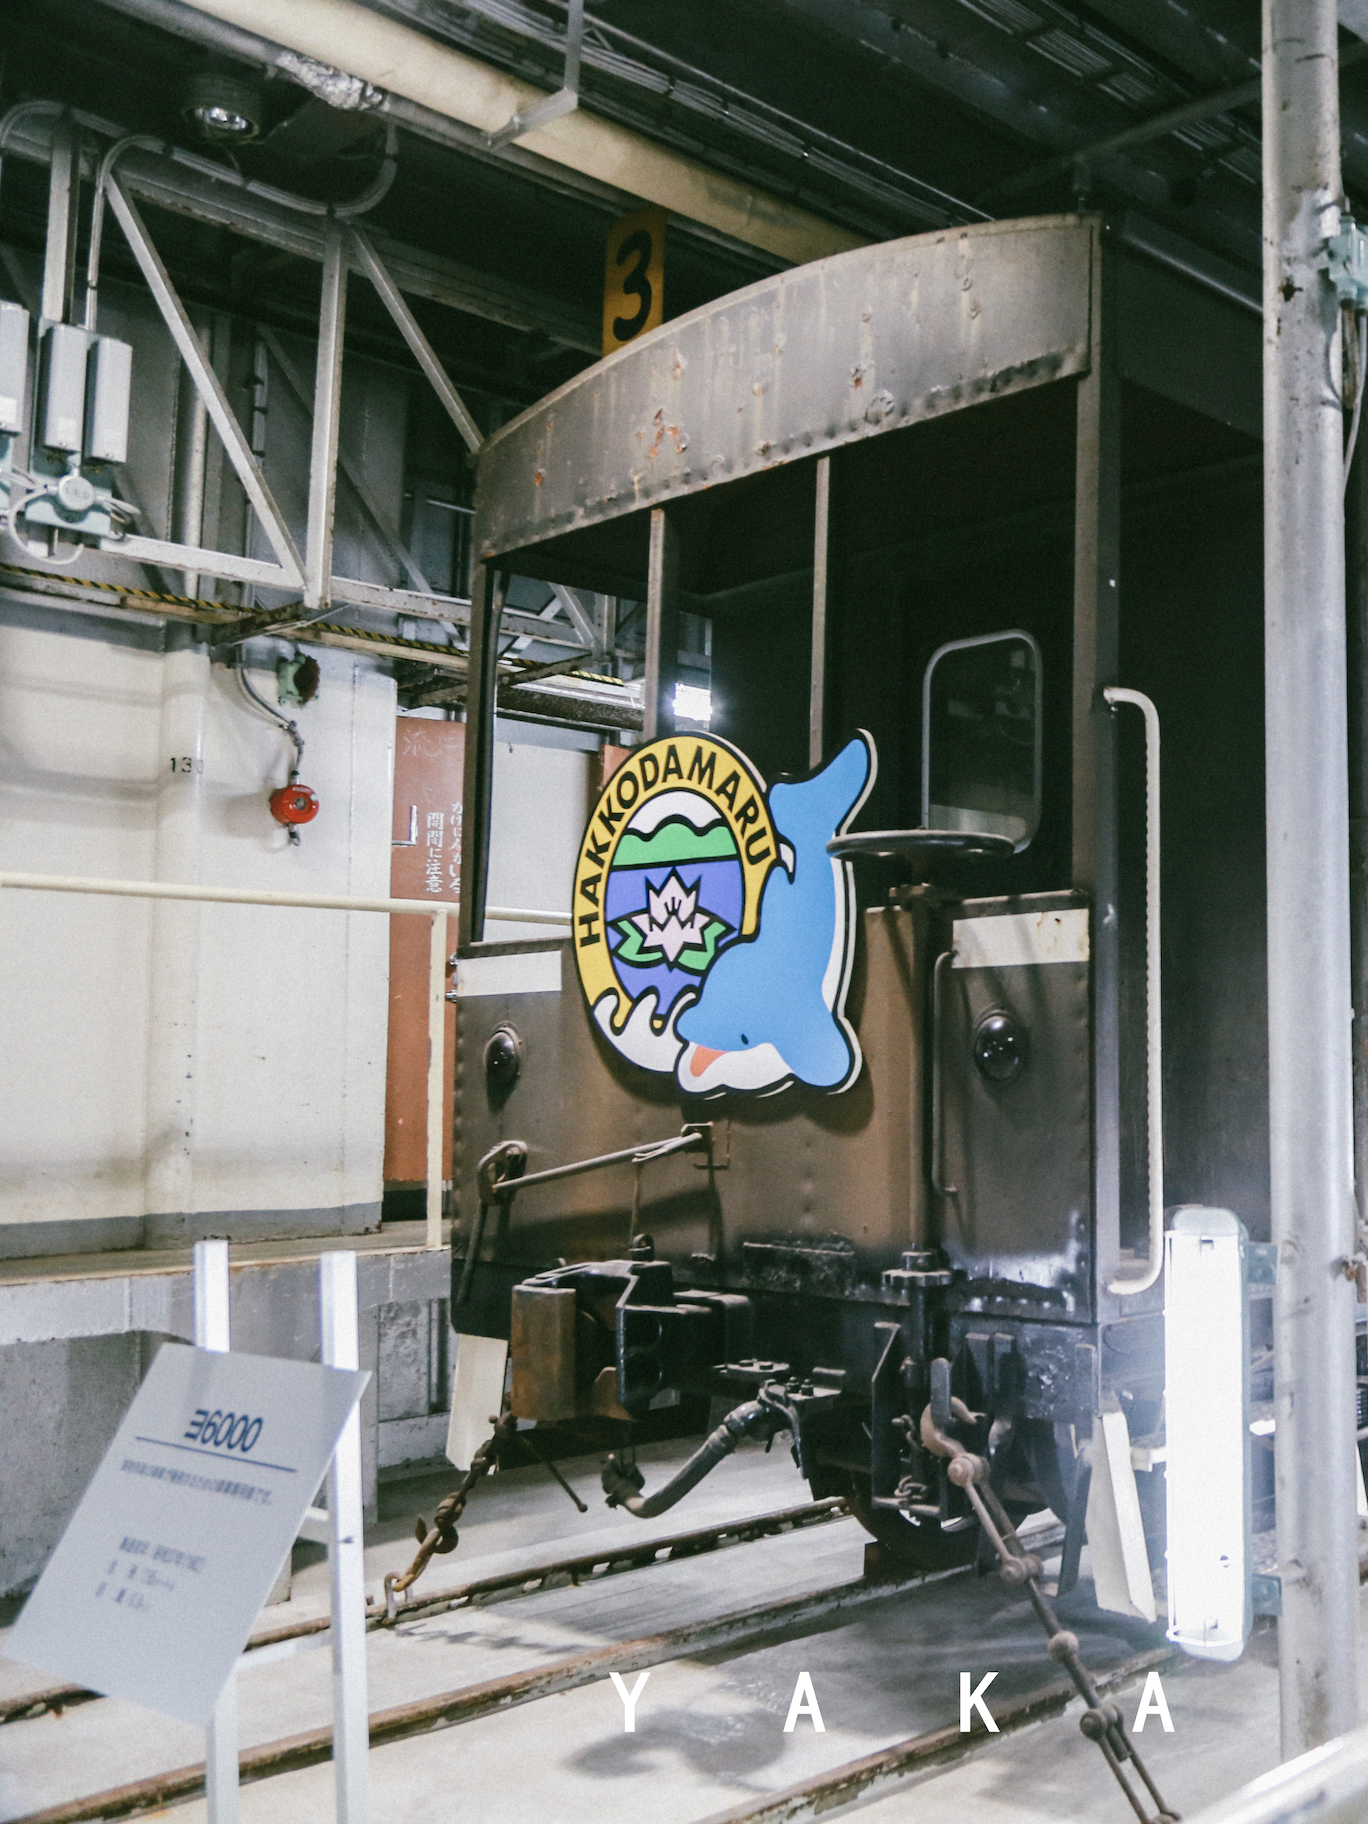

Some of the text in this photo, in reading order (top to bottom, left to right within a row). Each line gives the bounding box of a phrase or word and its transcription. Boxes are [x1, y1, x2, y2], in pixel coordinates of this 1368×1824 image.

[613, 230, 653, 342] 3
[424, 811, 444, 893] 開閉に注意
[579, 744, 772, 948] HAKKODAMARU
